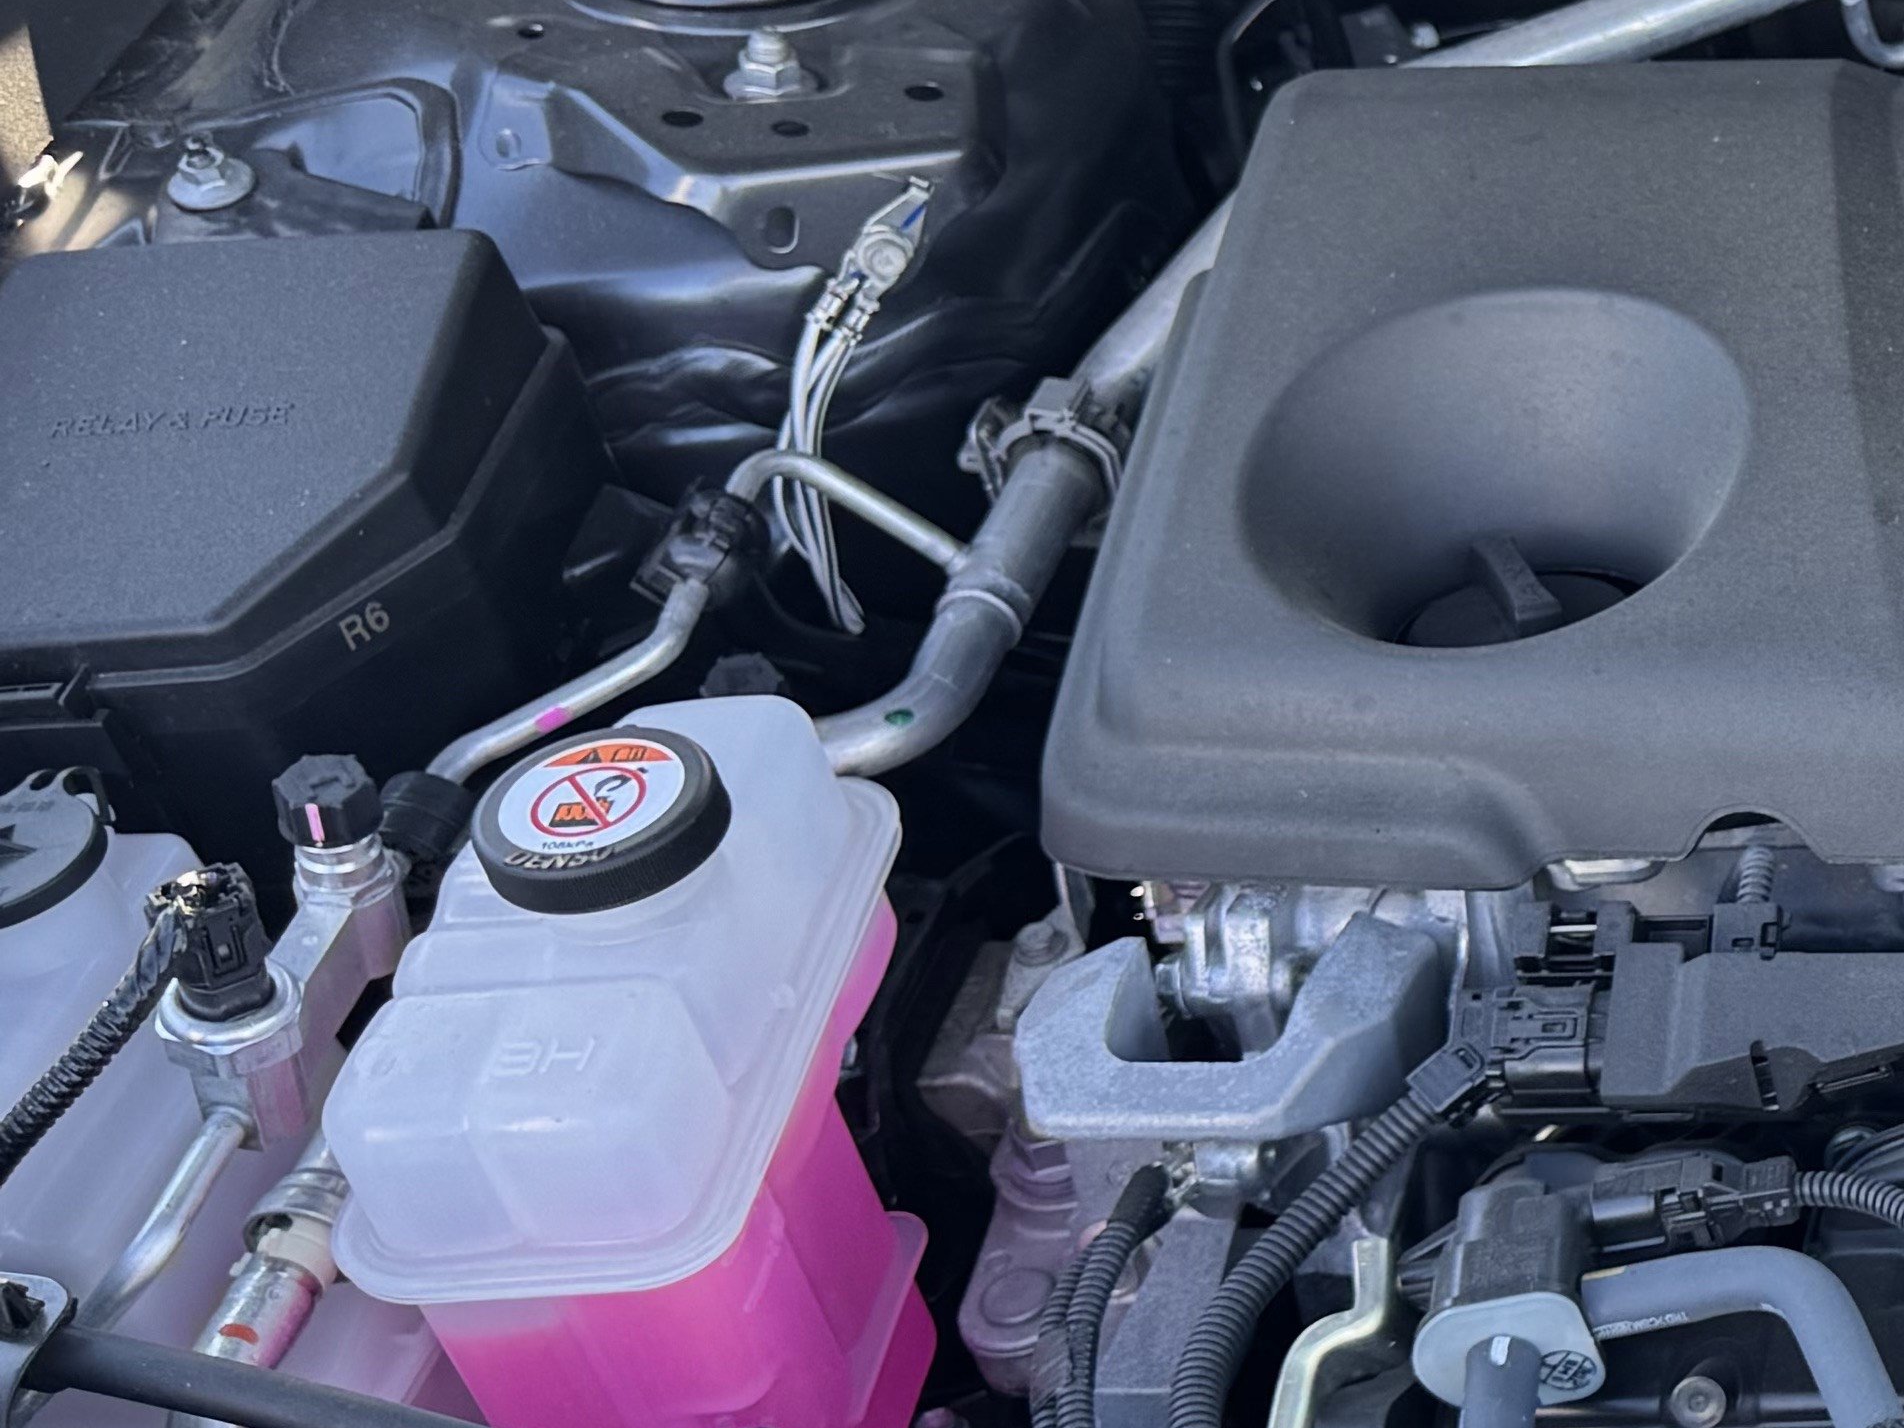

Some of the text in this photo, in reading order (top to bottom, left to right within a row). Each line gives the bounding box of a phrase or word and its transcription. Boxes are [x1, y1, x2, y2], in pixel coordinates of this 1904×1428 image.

[51, 412, 167, 439] RELAY
[202, 403, 296, 429] FUSE
[339, 601, 390, 651] R6
